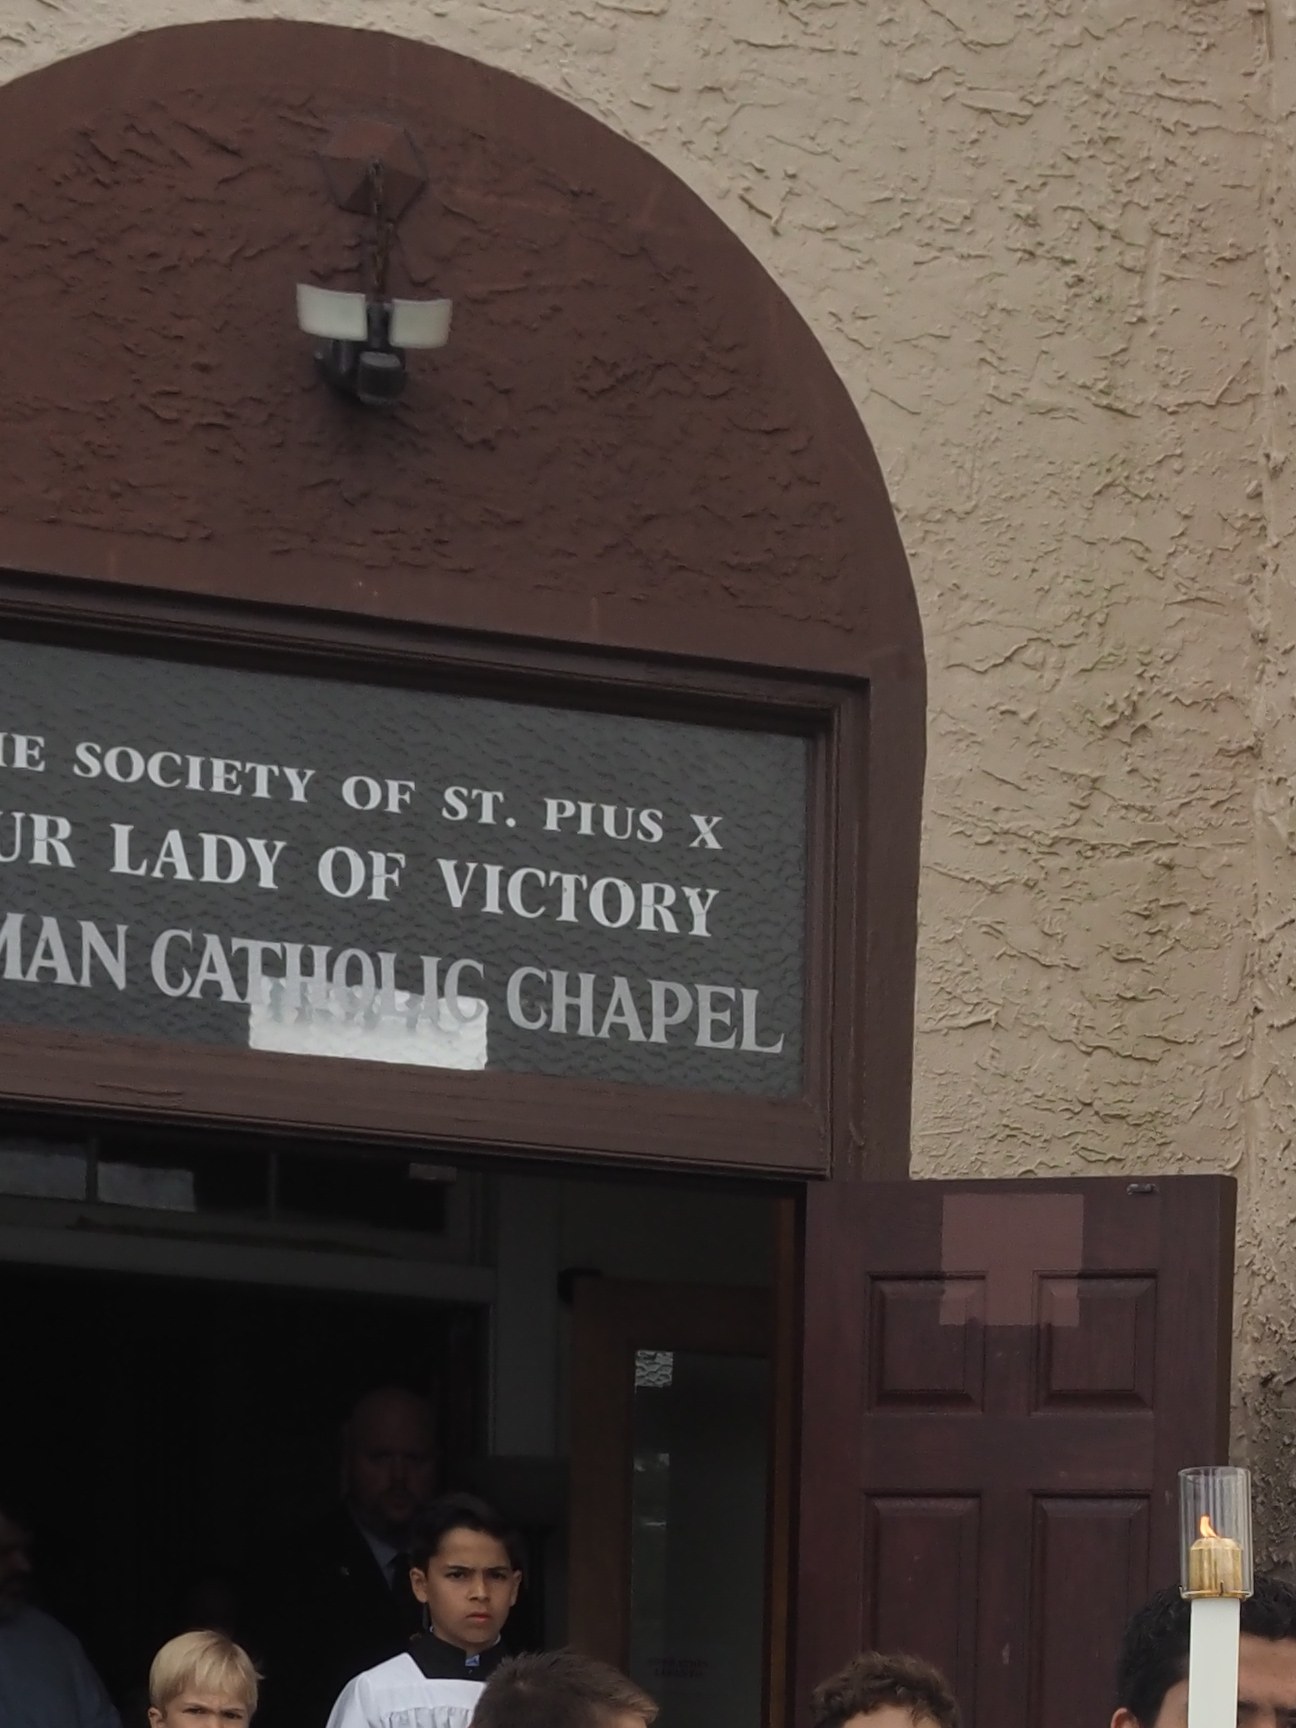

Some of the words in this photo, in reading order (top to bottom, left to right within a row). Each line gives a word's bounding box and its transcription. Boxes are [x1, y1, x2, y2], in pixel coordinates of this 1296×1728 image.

[73, 741, 316, 803] SOCIETY
[342, 775, 416, 814] OF
[442, 785, 516, 828] ST.
[543, 797, 664, 843] PIUS
[689, 813, 723, 850] X
[109, 822, 287, 890] LADY
[318, 846, 407, 903] OF
[437, 858, 720, 938] VICTORY
[151, 928, 487, 1027] CATHOLIC
[506, 966, 785, 1054] CHAPEL
